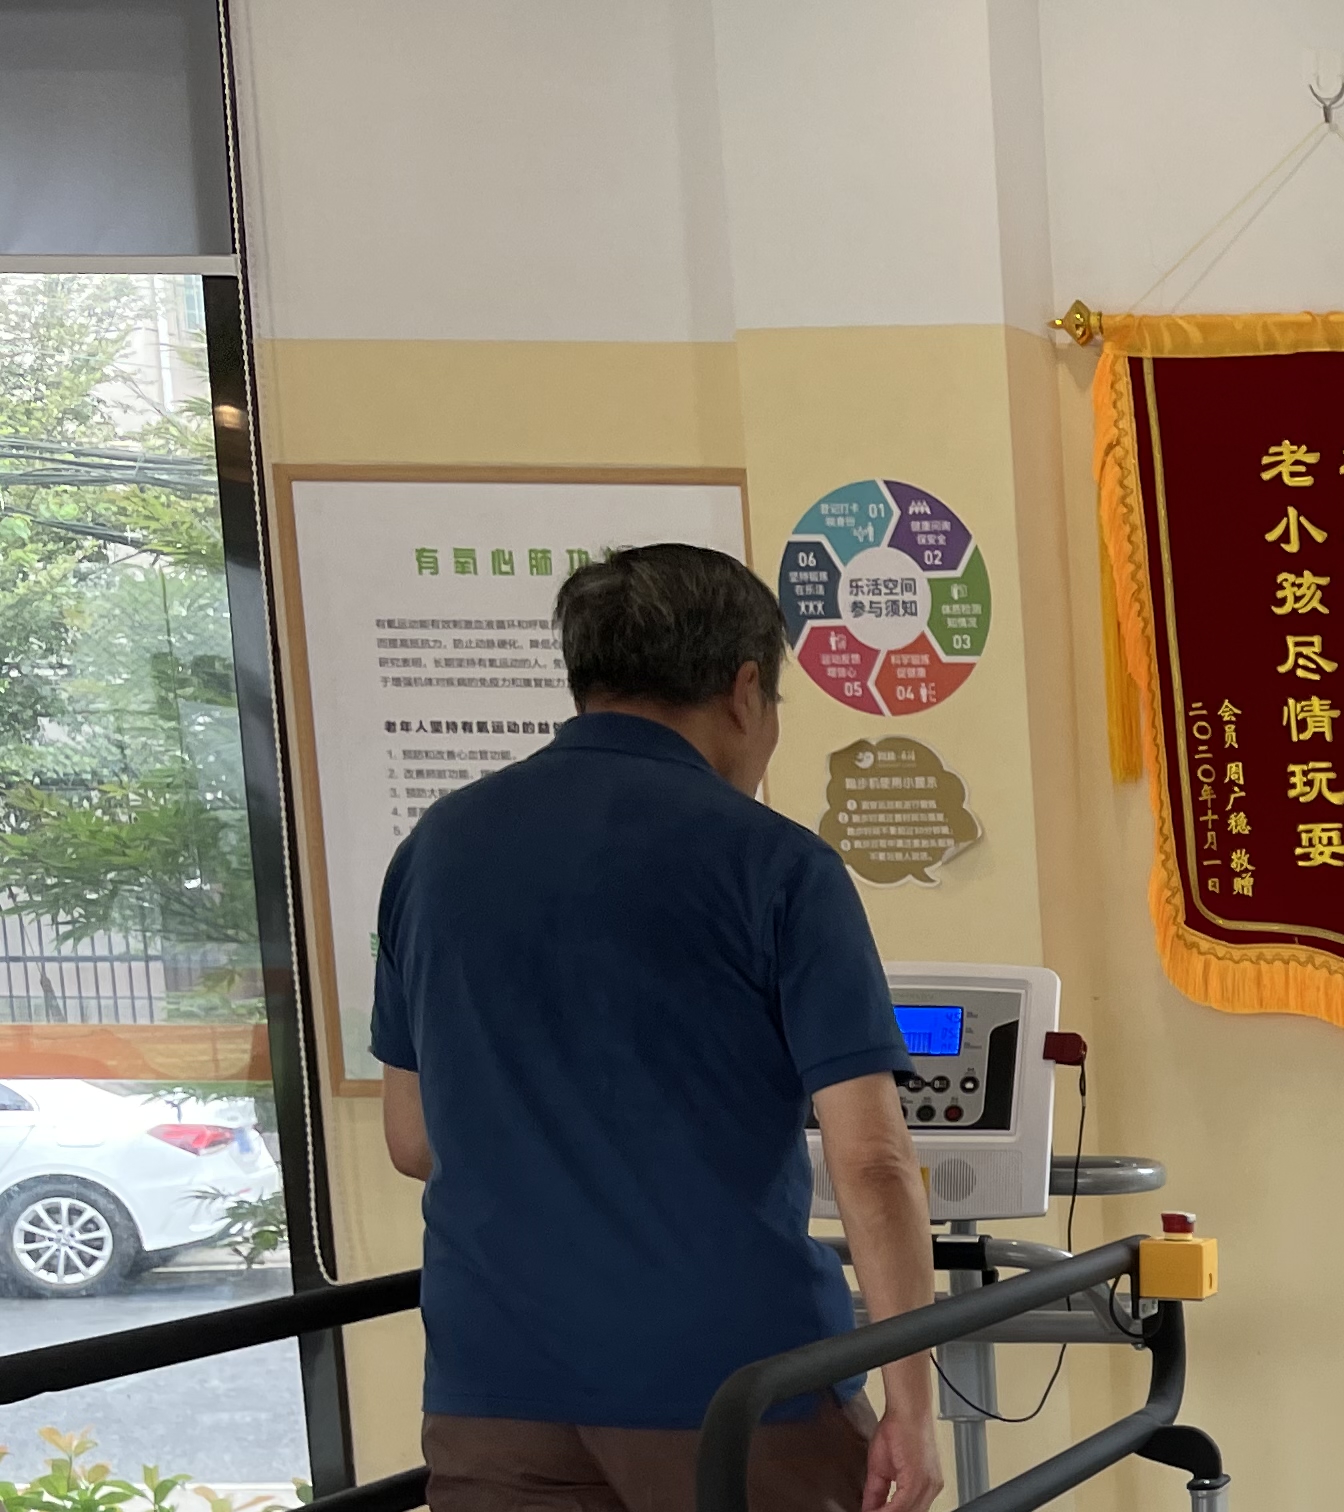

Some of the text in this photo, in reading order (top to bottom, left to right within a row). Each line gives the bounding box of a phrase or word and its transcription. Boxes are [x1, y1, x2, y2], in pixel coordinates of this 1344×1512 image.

[868, 503, 886, 518] 01
[798, 552, 817, 567] 06
[924, 550, 943, 565] 02
[849, 577, 917, 597] 乐活空间
[850, 600, 918, 618] 参与须知
[952, 634, 971, 649] 03
[844, 681, 863, 697] 05
[896, 685, 915, 700] 04
[1217, 699, 1242, 748] 会员
